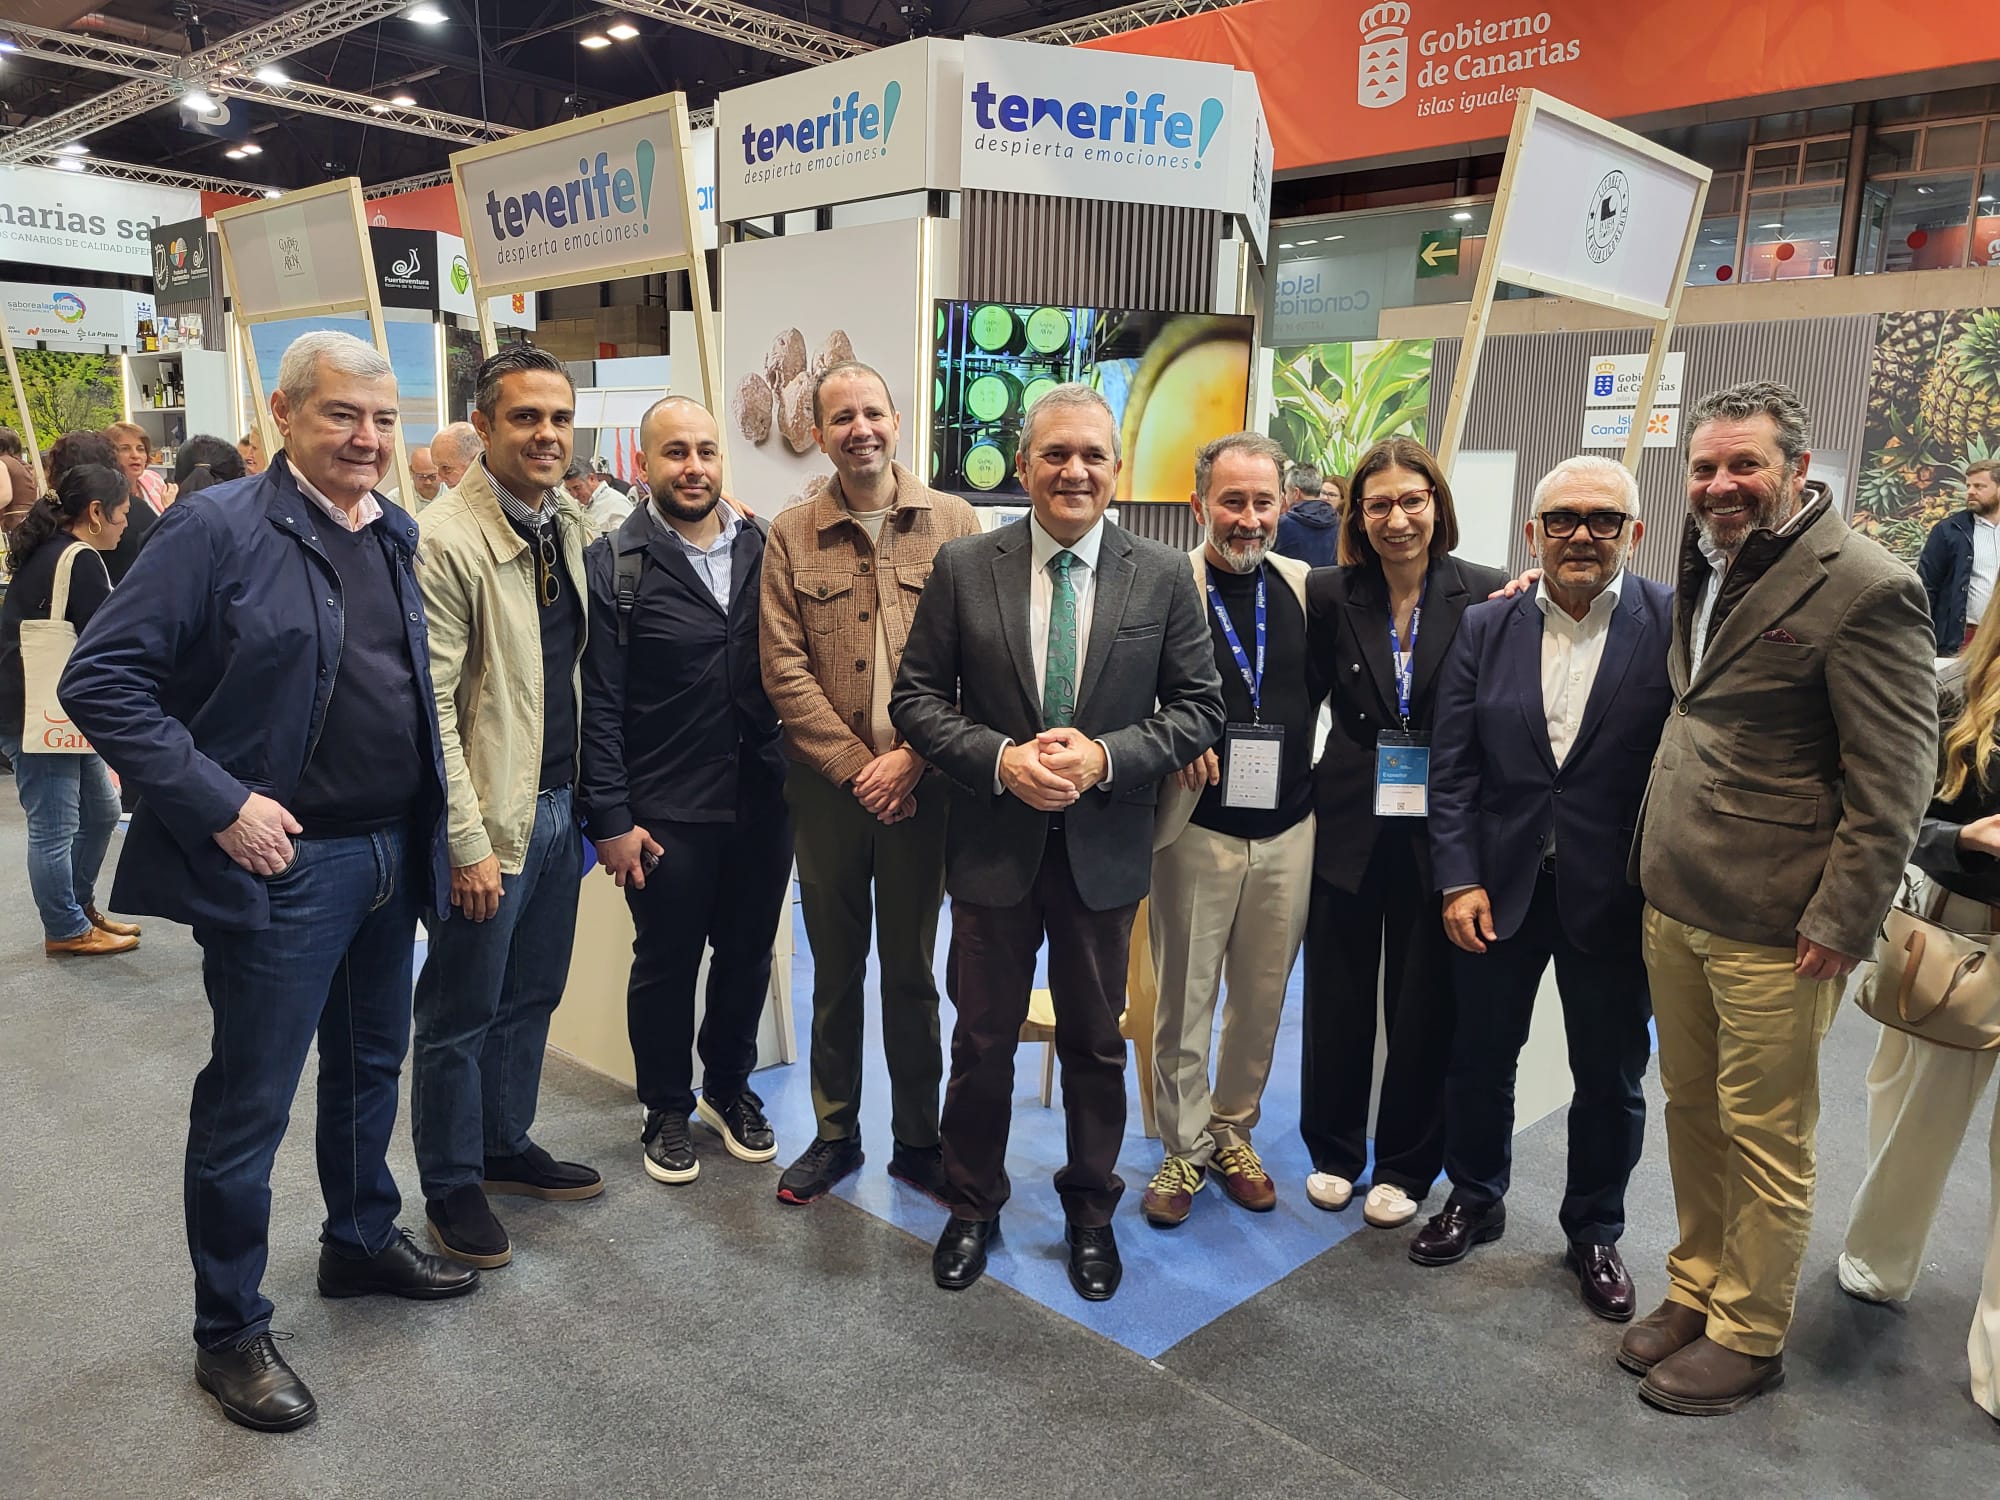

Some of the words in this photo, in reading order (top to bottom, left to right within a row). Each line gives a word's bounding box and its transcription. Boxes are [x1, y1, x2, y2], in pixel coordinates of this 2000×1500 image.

[1418, 12, 1551, 57] Gobierno
[1417, 60, 1449, 89] de
[1453, 38, 1581, 81] Canarias
[1417, 93, 1455, 117] islas
[1459, 84, 1522, 113] iguales
[741, 80, 902, 165] tenerife!
[970, 80, 1224, 170] tenerife!
[744, 161, 802, 185] despierta
[807, 146, 878, 172] emociones
[974, 133, 1074, 158] despierta
[1084, 146, 1189, 170] emociones
[485, 138, 656, 242] tenerife!
[10, 231, 63, 246] CANARIOS
[65, 238, 79, 248] DE
[80, 240, 123, 254] CALIDAD
[497, 238, 558, 266] despierta
[564, 222, 640, 252] emociones
[384, 276, 430, 286] Fuerteventura
[1616, 383, 1629, 393] de
[1630, 382, 1676, 393] Carias
[1617, 372, 1666, 383] Gobio
[1590, 424, 1631, 435] Canari
[1618, 414, 1632, 425] Isl
